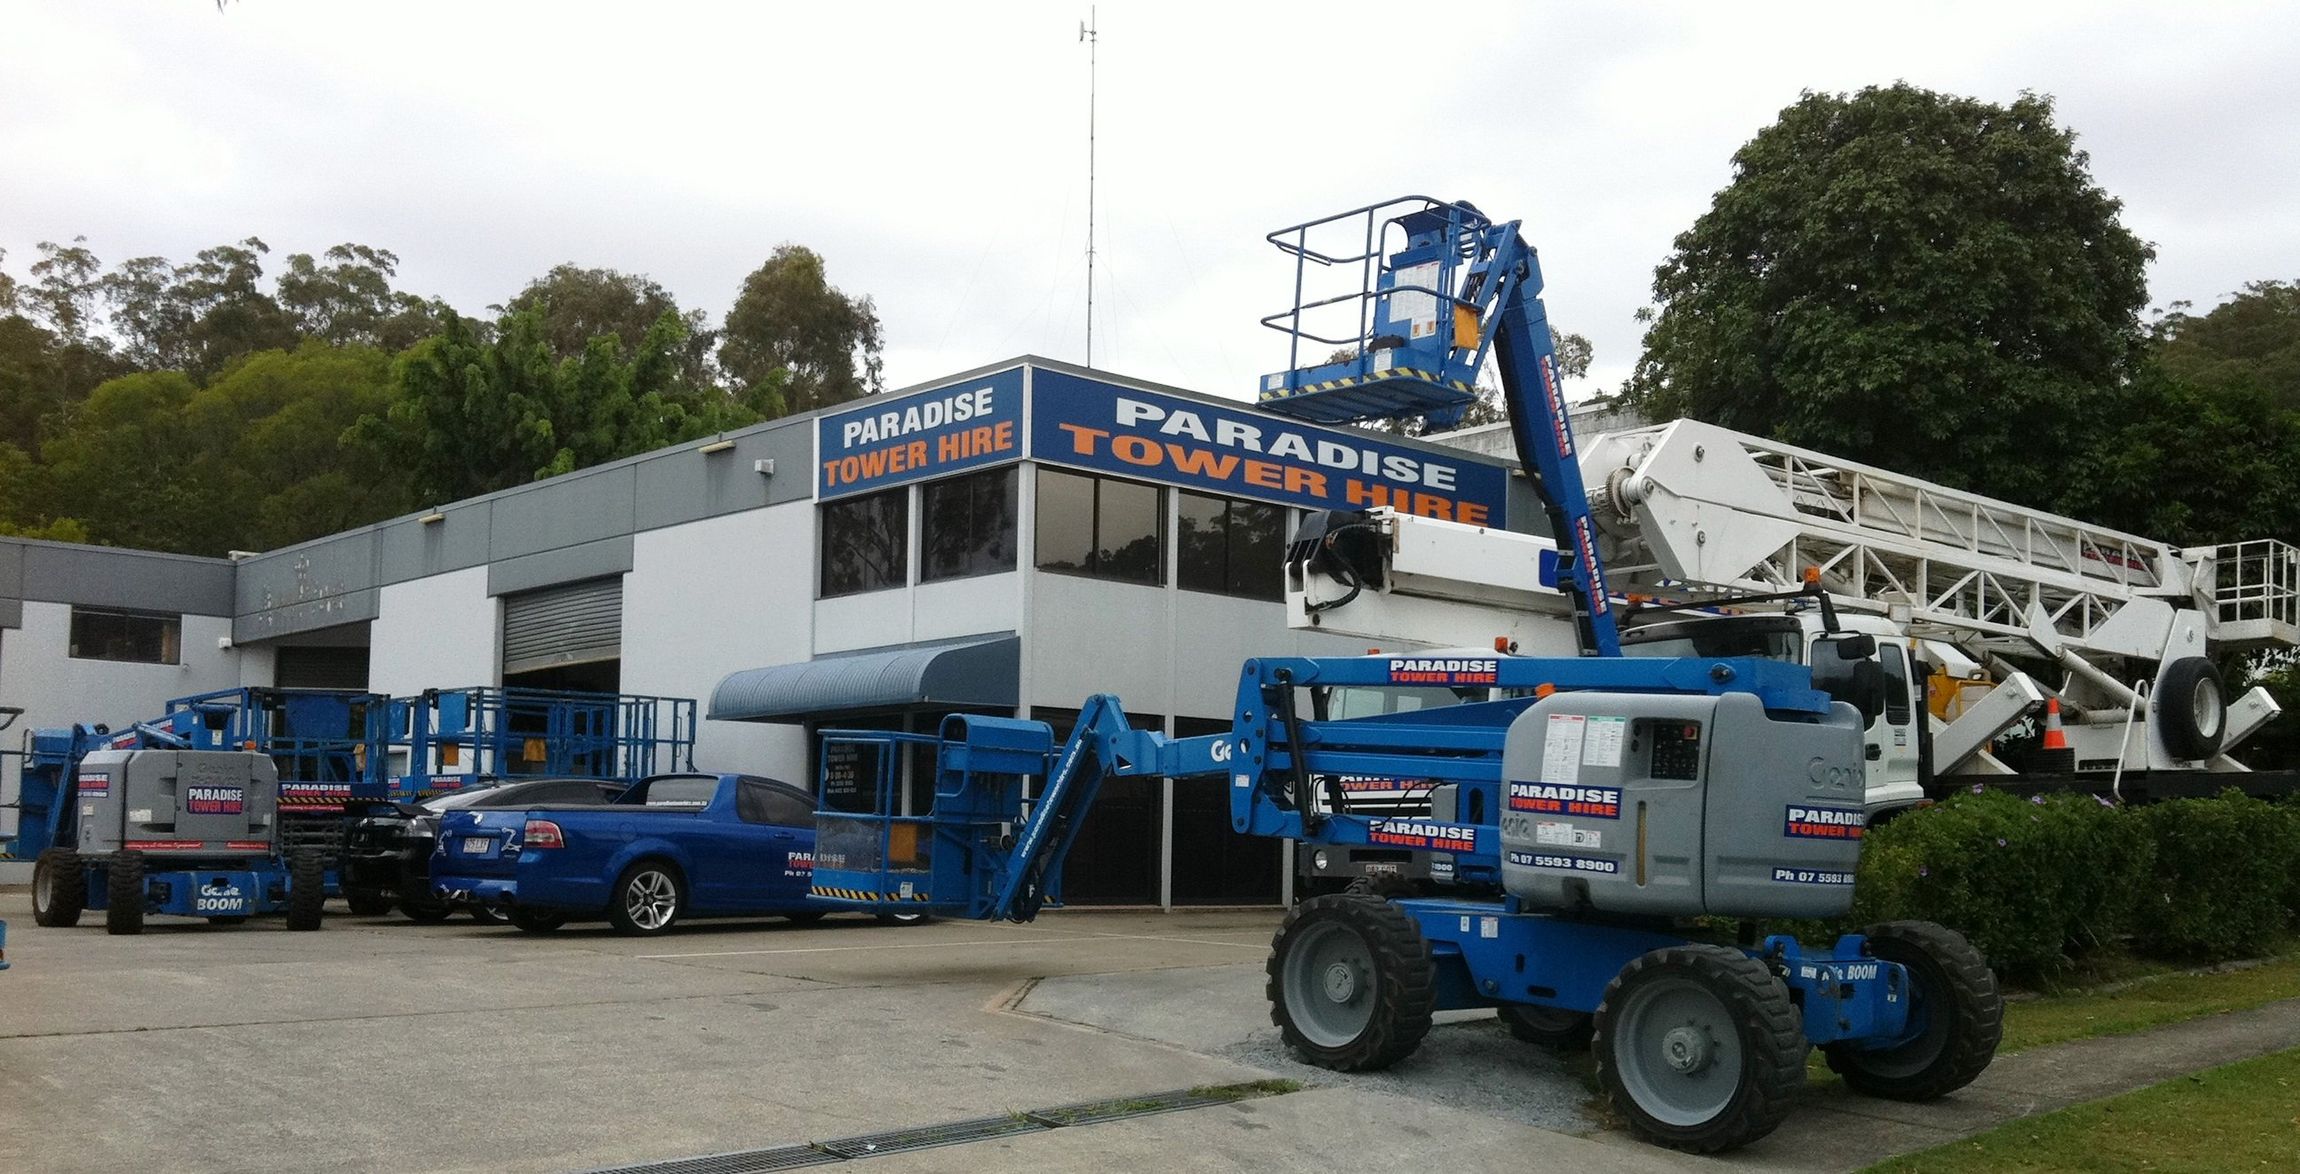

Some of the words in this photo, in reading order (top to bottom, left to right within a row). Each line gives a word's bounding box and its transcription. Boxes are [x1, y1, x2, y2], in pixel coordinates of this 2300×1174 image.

[1545, 354, 1572, 455] PARADISE
[844, 387, 993, 449] PARADISE
[1117, 397, 1456, 491] PARADISE
[823, 440, 927, 487] TOWER
[938, 421, 1013, 463] HIRE
[1059, 423, 1328, 498] TOWER
[1346, 479, 1488, 527] HIRE
[1580, 515, 1607, 613] PARADISE
[1390, 660, 1497, 672] PARADISE
[1391, 672, 1448, 683] TOWER
[1454, 673, 1496, 683] HIRE
[188, 788, 243, 801] PARADISE
[282, 783, 351, 791] PARADISE
[1511, 784, 1618, 804] PARADISE
[189, 801, 220, 812] TOWER
[223, 801, 242, 812] HIRE
[1510, 797, 1561, 811] TOWER
[1568, 802, 1617, 816] HIRE
[1788, 808, 1864, 826] PARADIS
[1370, 820, 1474, 840] PARADISE
[1788, 822, 1847, 837] TOWER
[1370, 832, 1426, 846] TOWER
[1432, 839, 1474, 851] HIRE
[1510, 853, 1519, 862] Ph
[1520, 855, 1532, 864] 07
[1535, 856, 1572, 869] 5593
[1575, 859, 1615, 872] 8900
[1776, 869, 1794, 881] Ph
[1798, 871, 1815, 882] 07
[1818, 873, 1842, 884] 5593
[197, 898, 243, 911] BOOM
[1847, 964, 1878, 980] BOOM
